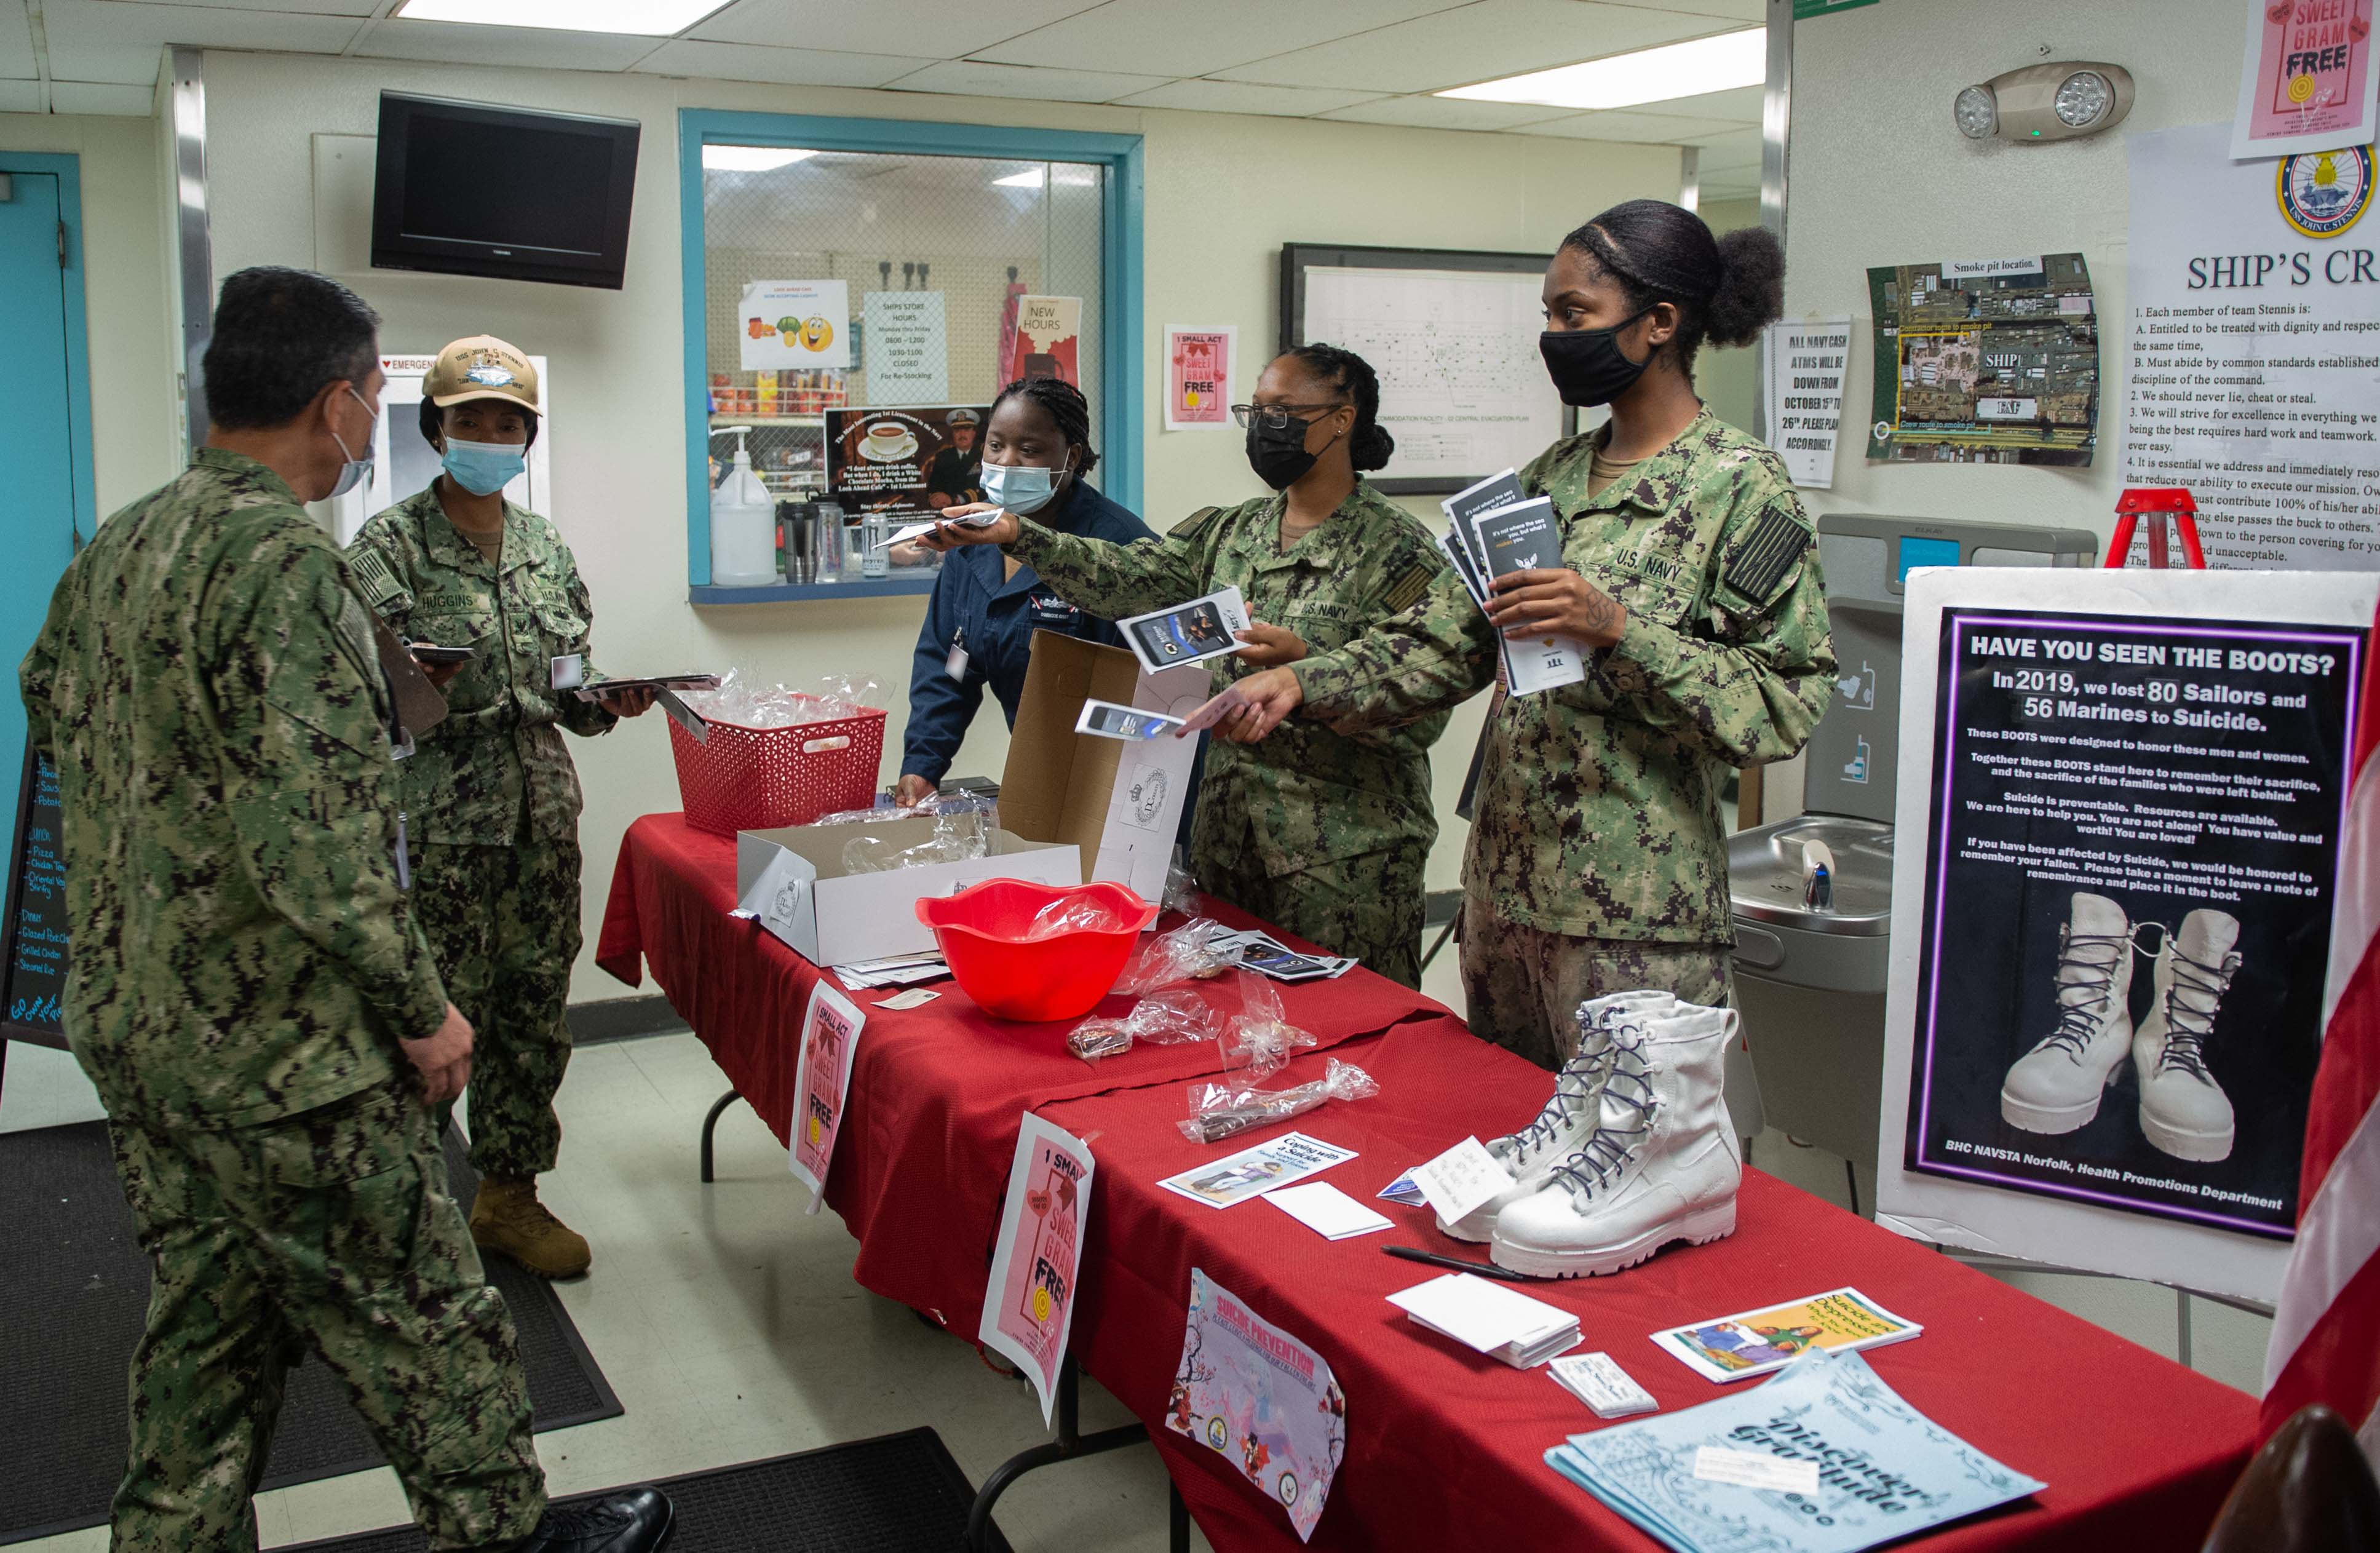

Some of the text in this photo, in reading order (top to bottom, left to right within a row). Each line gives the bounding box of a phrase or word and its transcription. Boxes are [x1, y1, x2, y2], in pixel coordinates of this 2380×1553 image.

[2296, 0, 2345, 25] SWEET
[2294, 23, 2344, 50] GRAM
[2286, 44, 2347, 79] FREE
[2290, 198, 2363, 231] USS JOHN C. STENNIS
[1954, 258, 2034, 273] Smoke pit location.
[1031, 307, 1055, 317] NEW
[2136, 303, 2311, 318] 1. Each member of team Stennis is:
[1023, 319, 1060, 330] HOURS
[1789, 335, 1847, 349] ALL NAVY CASH
[2133, 341, 2147, 351] the
[2177, 340, 2203, 352] time,
[392, 359, 435, 370] EMERGEN
[1186, 358, 1212, 368] SWEET
[1791, 355, 1843, 368] ATMS WILL BE
[1186, 370, 1212, 381] GRAM
[1793, 376, 1839, 389] DOWN FROM
[1184, 381, 1214, 394] FREE
[1784, 397, 1821, 410] OCTOBER
[2130, 391, 2138, 400] 2.
[2141, 391, 2156, 401] We
[2159, 391, 2192, 402] should
[2228, 391, 2245, 404] lie,
[2248, 392, 2274, 403] cheat
[2290, 393, 2316, 403] steal.
[1997, 400, 2021, 415] FAF
[1802, 418, 1824, 430] PLEASE
[1786, 437, 1832, 451] ACCORDINGLY.
[2149, 443, 2172, 454] easy.
[1914, 526, 1945, 535] ELKAY
[1617, 548, 1684, 583] U.S. NAVY
[422, 594, 474, 610] HUGGINS
[1319, 604, 1349, 620] NAVY
[1972, 636, 2335, 675] HAVE YOU SEEN THE BOOTS?
[1994, 670, 2306, 709] In 2019, we lost 80 Sailors and
[2024, 697, 2267, 732] 56 Marines to Suicide.
[1967, 728, 2309, 763] These BOOTS were designed to honor these men and women.
[2004, 792, 2278, 827] Suicide is preventable. Resources are available.
[819, 1007, 836, 1029] SMALL
[836, 1022, 848, 1039] ACT
[814, 1052, 835, 1082] SWEET
[813, 1074, 833, 1105] GRAM
[809, 1092, 833, 1132] FREE
[1284, 1138, 1339, 1160] Coping with
[1285, 1148, 1322, 1162] Suicide
[1945, 1140, 2283, 1210] BHC NAVSTA Norfolk, Health Promotions Department
[1827, 1294, 1871, 1321] Suicide
[1814, 1298, 1882, 1336] Depression
[1216, 1294, 1315, 1379] SUICIDE PREVENTION
[1767, 1418, 1930, 1501] Discover
[1727, 1425, 1908, 1511] Gratude
